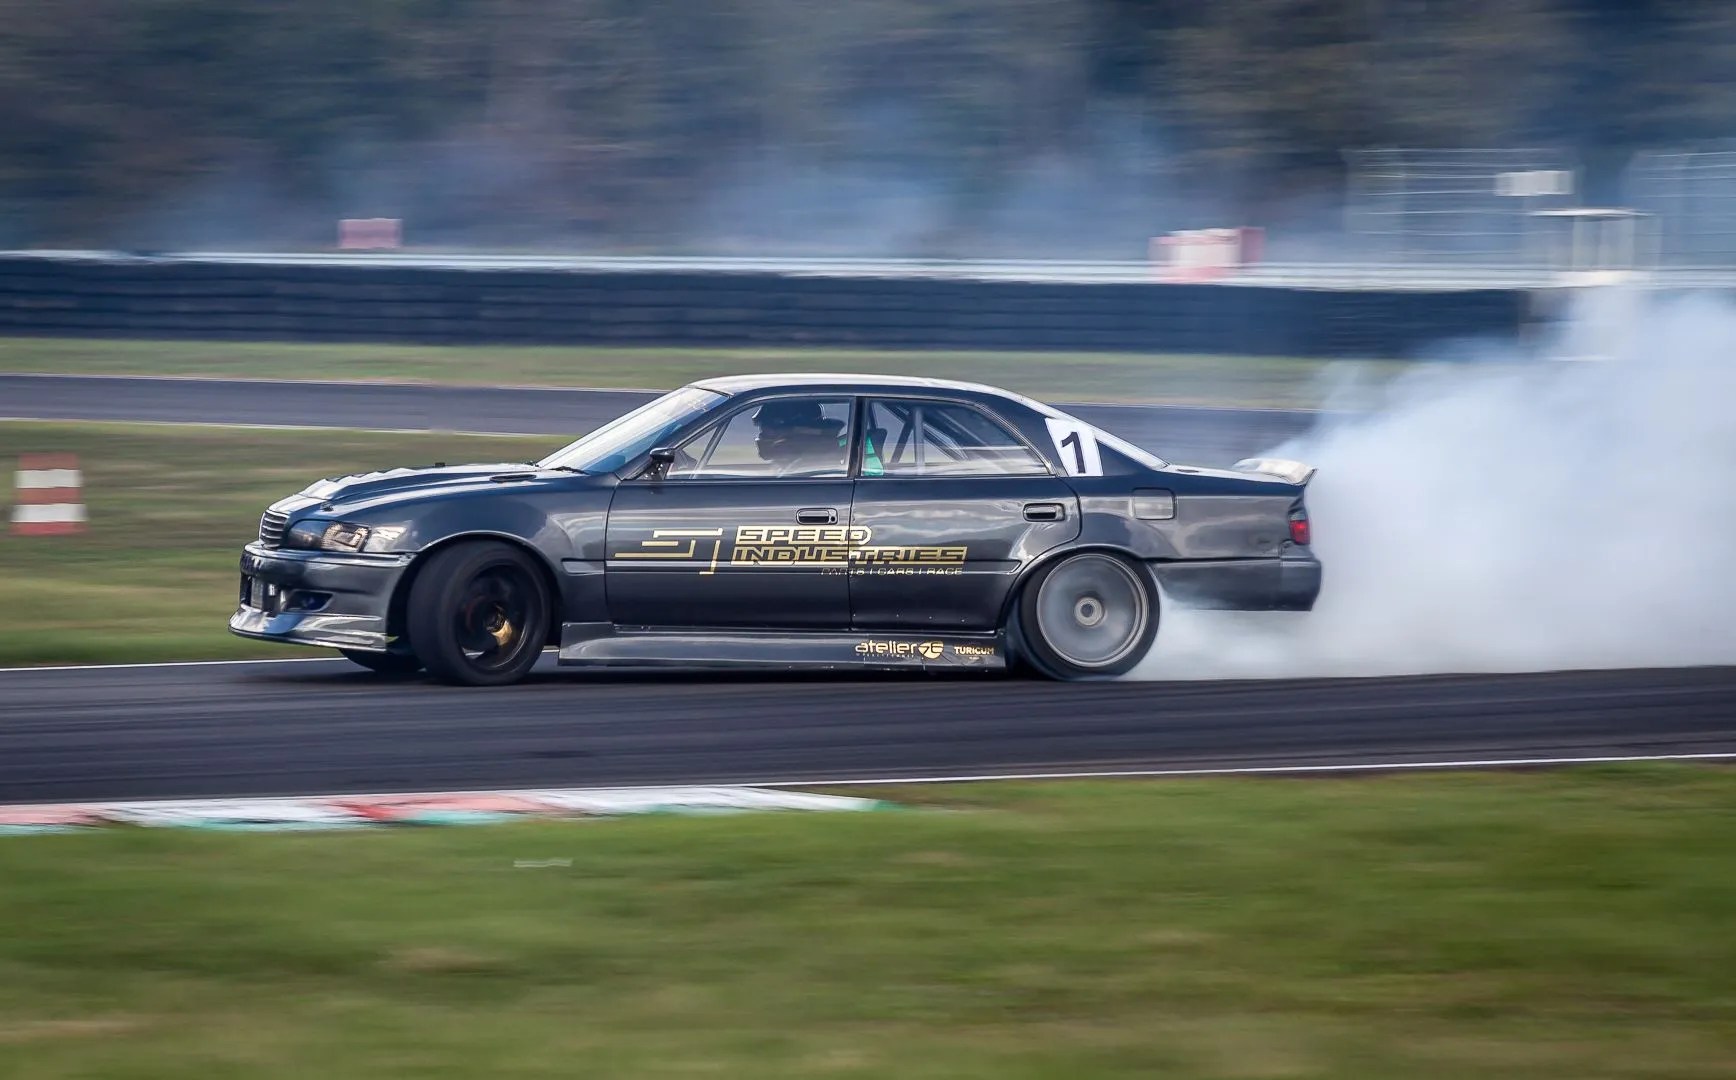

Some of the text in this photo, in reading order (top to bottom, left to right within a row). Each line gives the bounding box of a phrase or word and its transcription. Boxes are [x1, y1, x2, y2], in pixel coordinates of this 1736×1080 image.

[1061, 431, 1086, 474] 1
[735, 525, 872, 545] SPEED
[731, 546, 967, 567] INDUSTRIES
[877, 567, 914, 575] CARS
[926, 567, 963, 575] RACE
[855, 640, 917, 654] atelier
[954, 646, 994, 655] TURICUM
